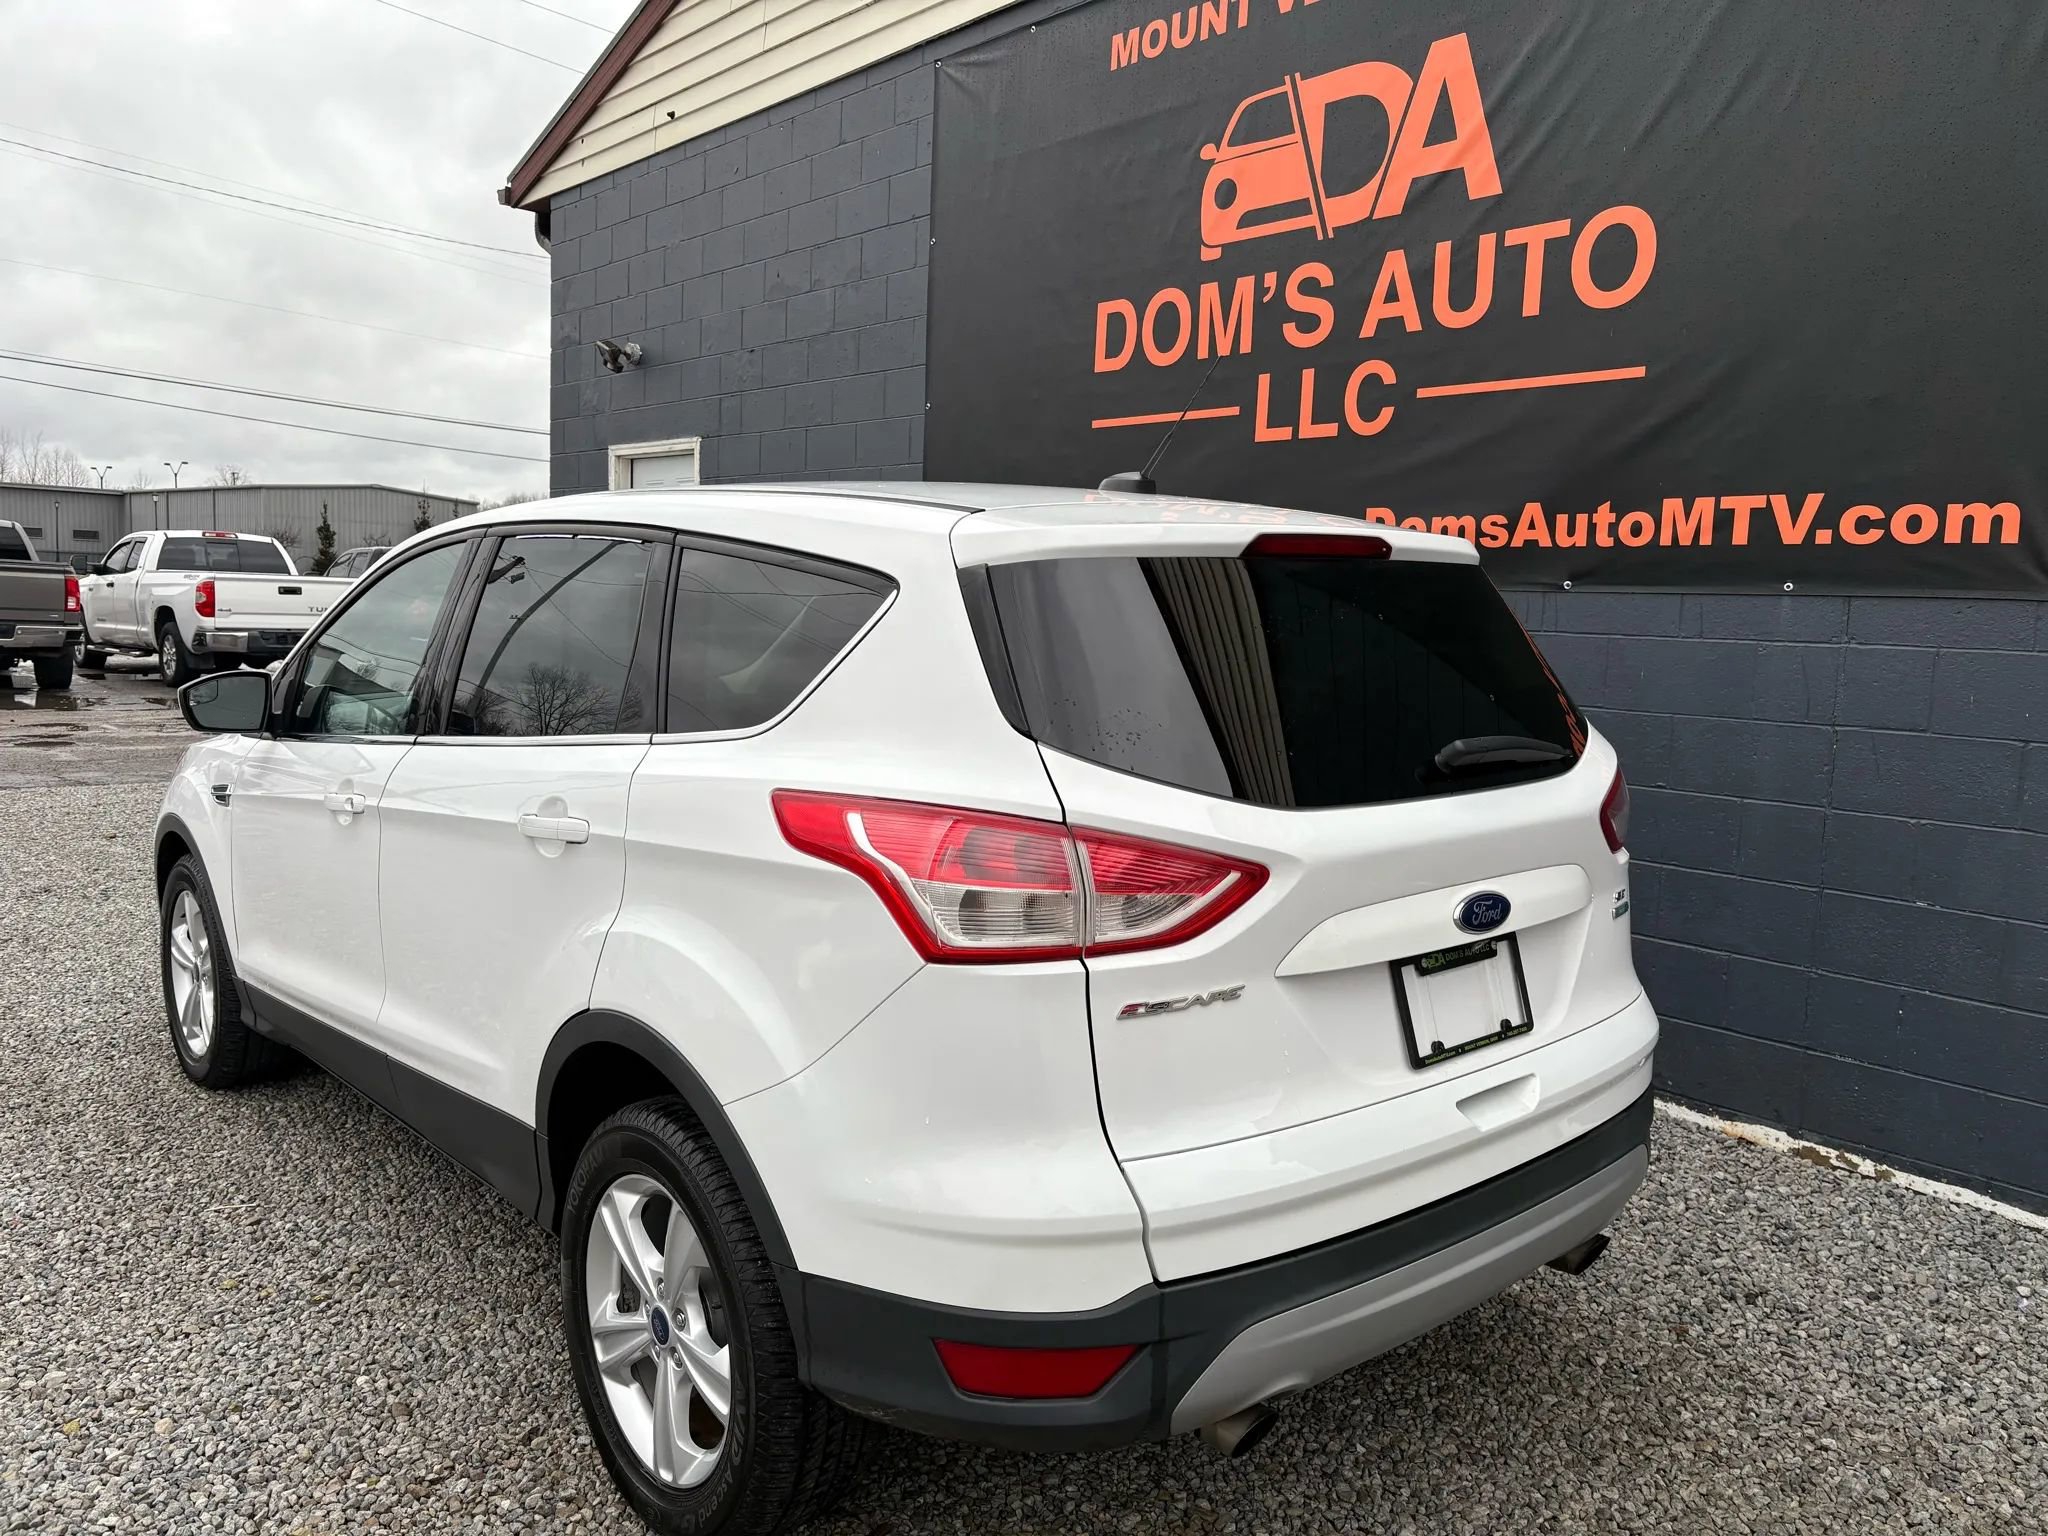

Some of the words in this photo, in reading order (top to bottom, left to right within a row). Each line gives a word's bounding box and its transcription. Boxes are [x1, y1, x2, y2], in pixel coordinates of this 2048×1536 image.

[1110, 0, 1249, 71] MOUNT
[1094, 262, 1335, 373] DOM'S
[1359, 206, 1657, 339] AUTO
[1255, 359, 1397, 443] LLC
[1472, 900, 1502, 925] Ford
